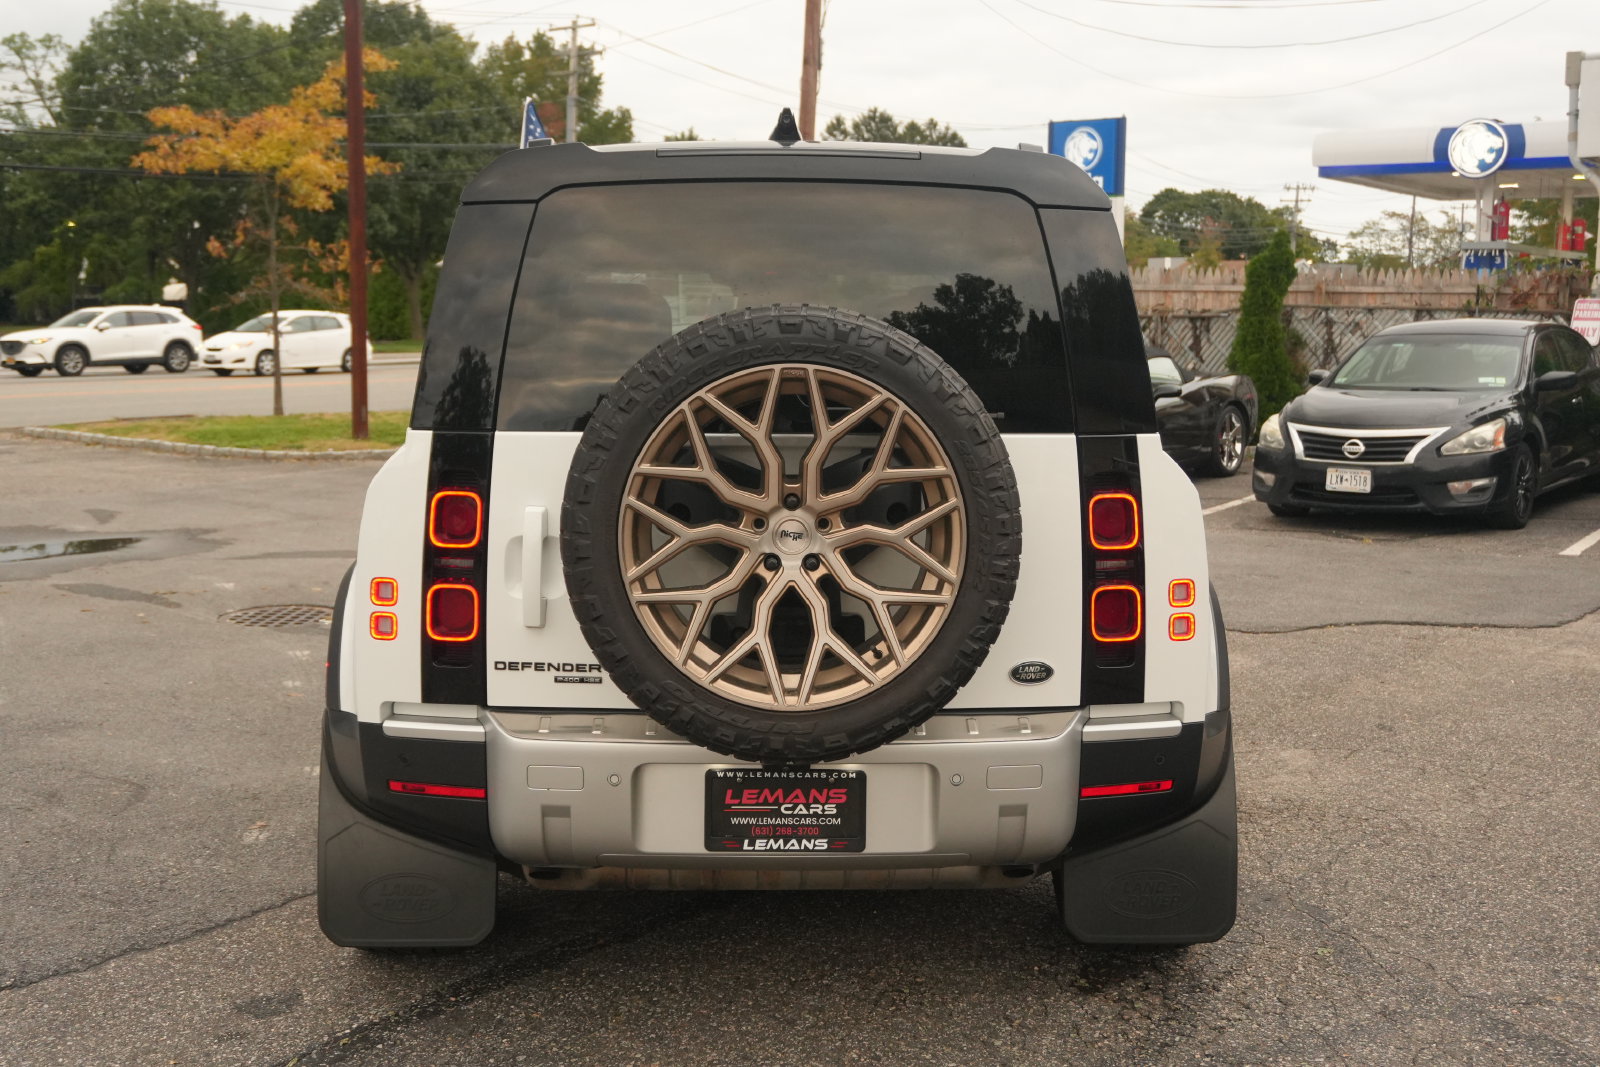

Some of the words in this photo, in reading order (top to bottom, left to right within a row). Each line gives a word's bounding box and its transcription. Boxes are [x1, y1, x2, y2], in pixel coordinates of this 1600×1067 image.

[494, 660, 602, 673] DEFENDER
[716, 771, 857, 779] WWW.LEMANSCARS.COM
[724, 788, 848, 805] LEMANS
[780, 804, 837, 815] CARS
[730, 817, 841, 825] WWW.LEMANSCARS.COM
[751, 826, 773, 837] (631)
[775, 826, 819, 836] 268-3700
[742, 838, 829, 851] LEMANS
